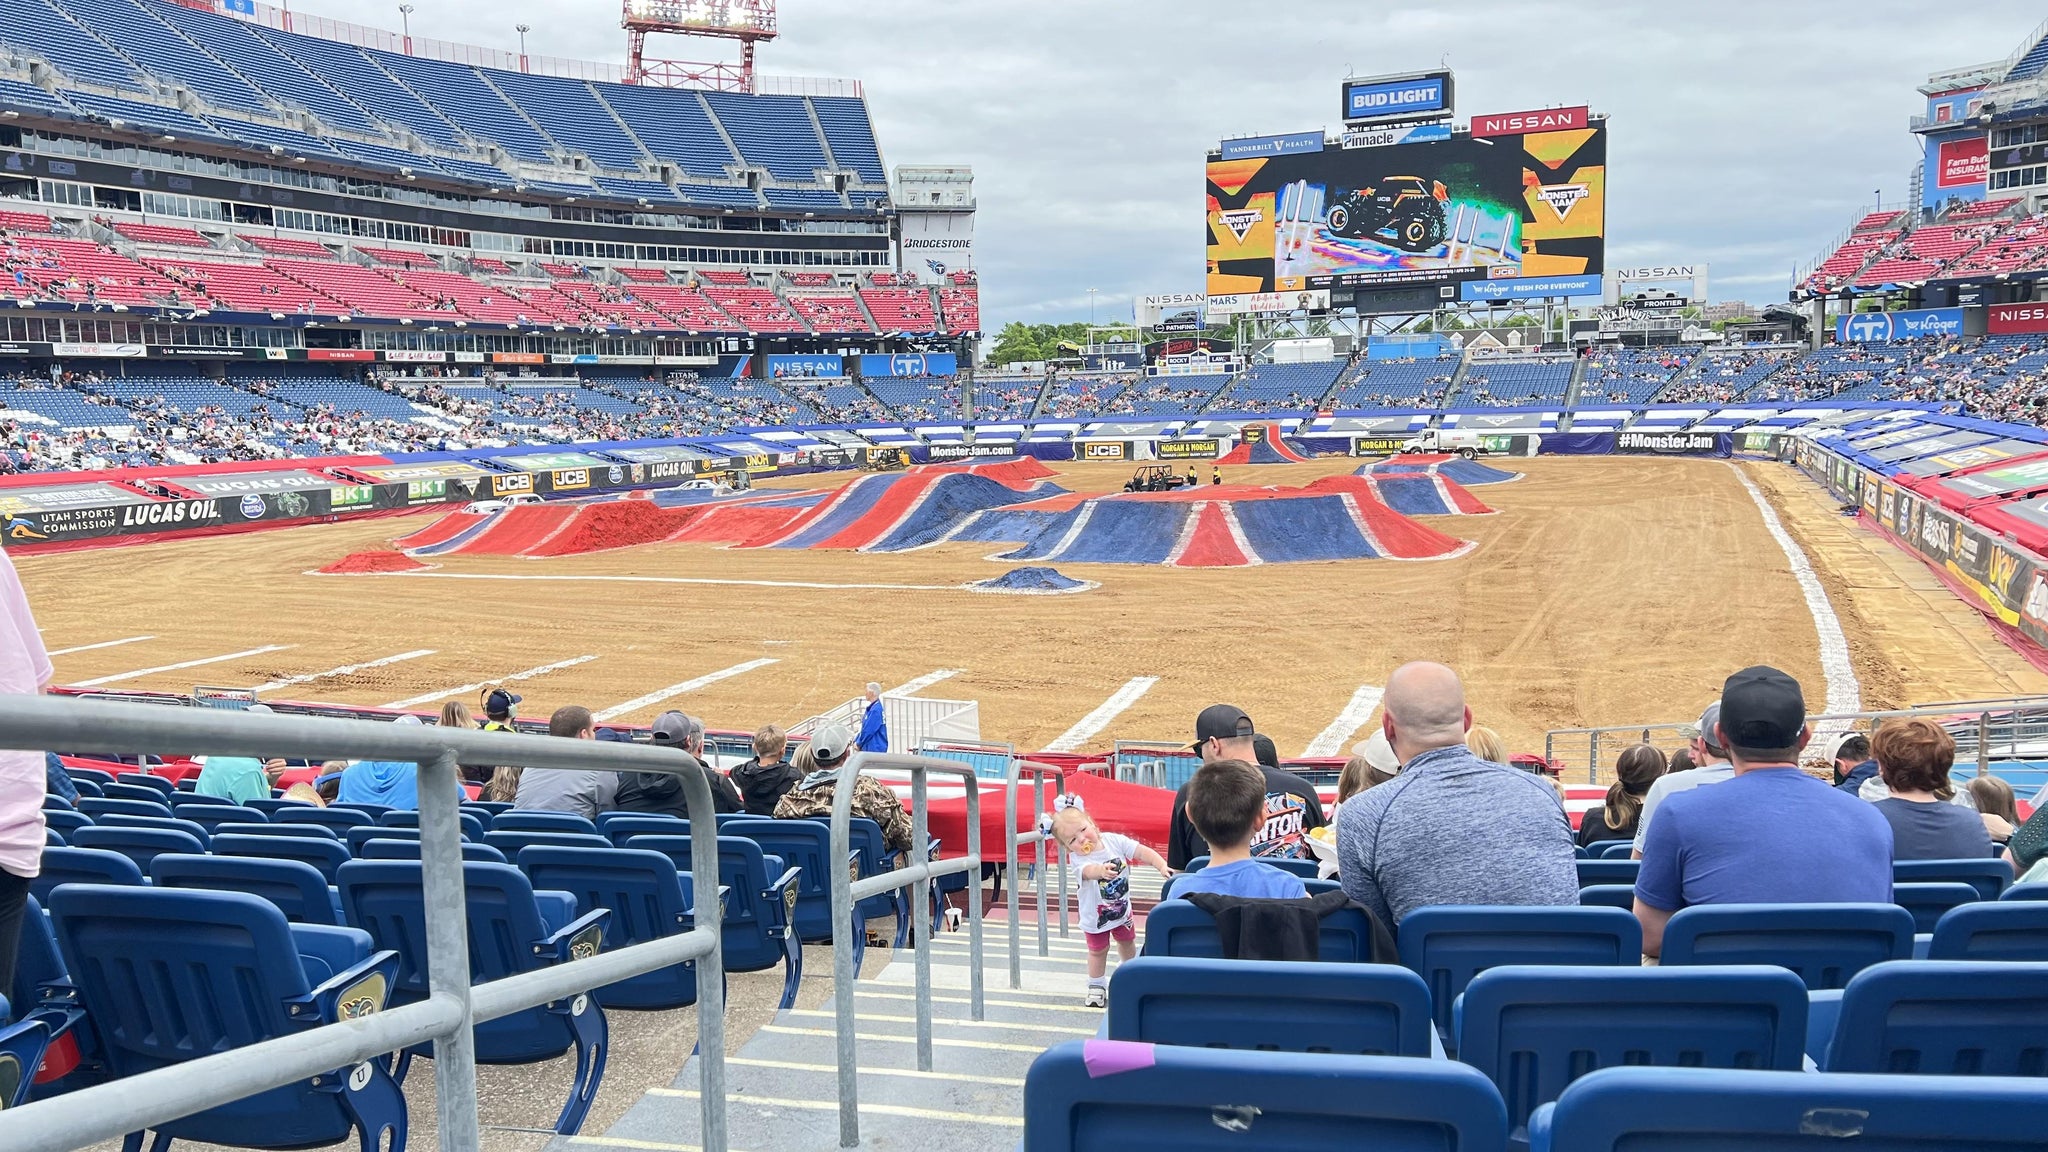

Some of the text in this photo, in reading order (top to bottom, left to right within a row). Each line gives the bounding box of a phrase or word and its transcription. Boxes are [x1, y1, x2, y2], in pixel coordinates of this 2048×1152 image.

[1354, 88, 1436, 108] BUD LIGHT
[1486, 113, 1572, 132] NISSAN
[1229, 143, 1272, 153] VANDERBILT
[1286, 139, 1313, 148] HEALTH
[1344, 132, 1393, 148] Pinnacle
[1947, 158, 1968, 167] Farm
[1537, 189, 1589, 201] MONSTER
[1549, 198, 1574, 207] JAM
[1219, 214, 1263, 224] MONSTER
[1230, 222, 1251, 230] JAM
[904, 238, 971, 248] BRIDGESTONE
[1495, 268, 1515, 276] JCB
[1618, 266, 1693, 279] NISSAN
[1484, 283, 1509, 296] Kroger
[1145, 293, 1205, 304] NISSAN
[1210, 295, 1238, 305] MARS
[1921, 314, 1959, 335] Kroger
[774, 362, 837, 371] NISSAN
[669, 371, 698, 379] TITANS
[1161, 443, 1215, 452] MORGAN & MORGAN
[1360, 441, 1387, 450] MORGAN
[1388, 441, 1394, 449] &
[1619, 433, 1713, 450] #MonsterJam
[930, 446, 1013, 457] MonsterJam.com
[1087, 445, 1121, 457] JCB
[745, 454, 769, 466] UNOH
[651, 463, 679, 478] LUCAS
[495, 475, 530, 491] JCB
[556, 470, 587, 486] JCB
[197, 478, 276, 493] LUCAS
[409, 480, 445, 495] BKT
[332, 486, 372, 503] BKT
[41, 508, 115, 523] UTAH SPORTS
[123, 502, 186, 526] LUCAS
[43, 519, 114, 533] COMMISSION
[576, 999, 583, 1011] T
[356, 1067, 365, 1083] U
